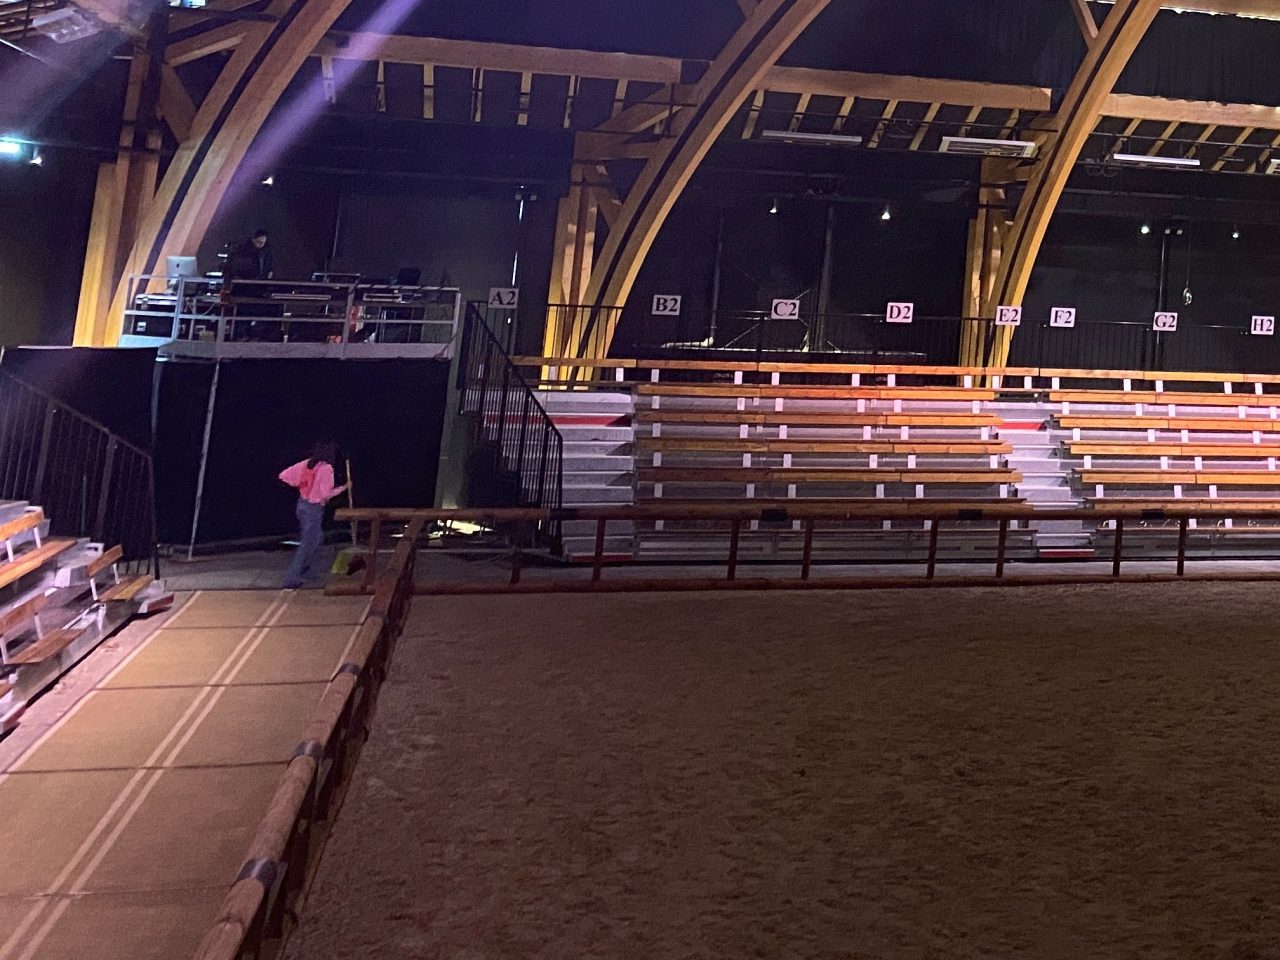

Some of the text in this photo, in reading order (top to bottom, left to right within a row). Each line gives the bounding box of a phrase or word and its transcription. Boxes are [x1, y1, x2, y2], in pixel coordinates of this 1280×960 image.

[489, 290, 516, 306] A2
[655, 297, 679, 313] B2
[773, 301, 797, 316] C2
[888, 305, 912, 320] D2
[998, 308, 1019, 323] E2
[1053, 310, 1073, 324] F2
[1154, 314, 1176, 328] G2
[1252, 318, 1273, 332] H2
